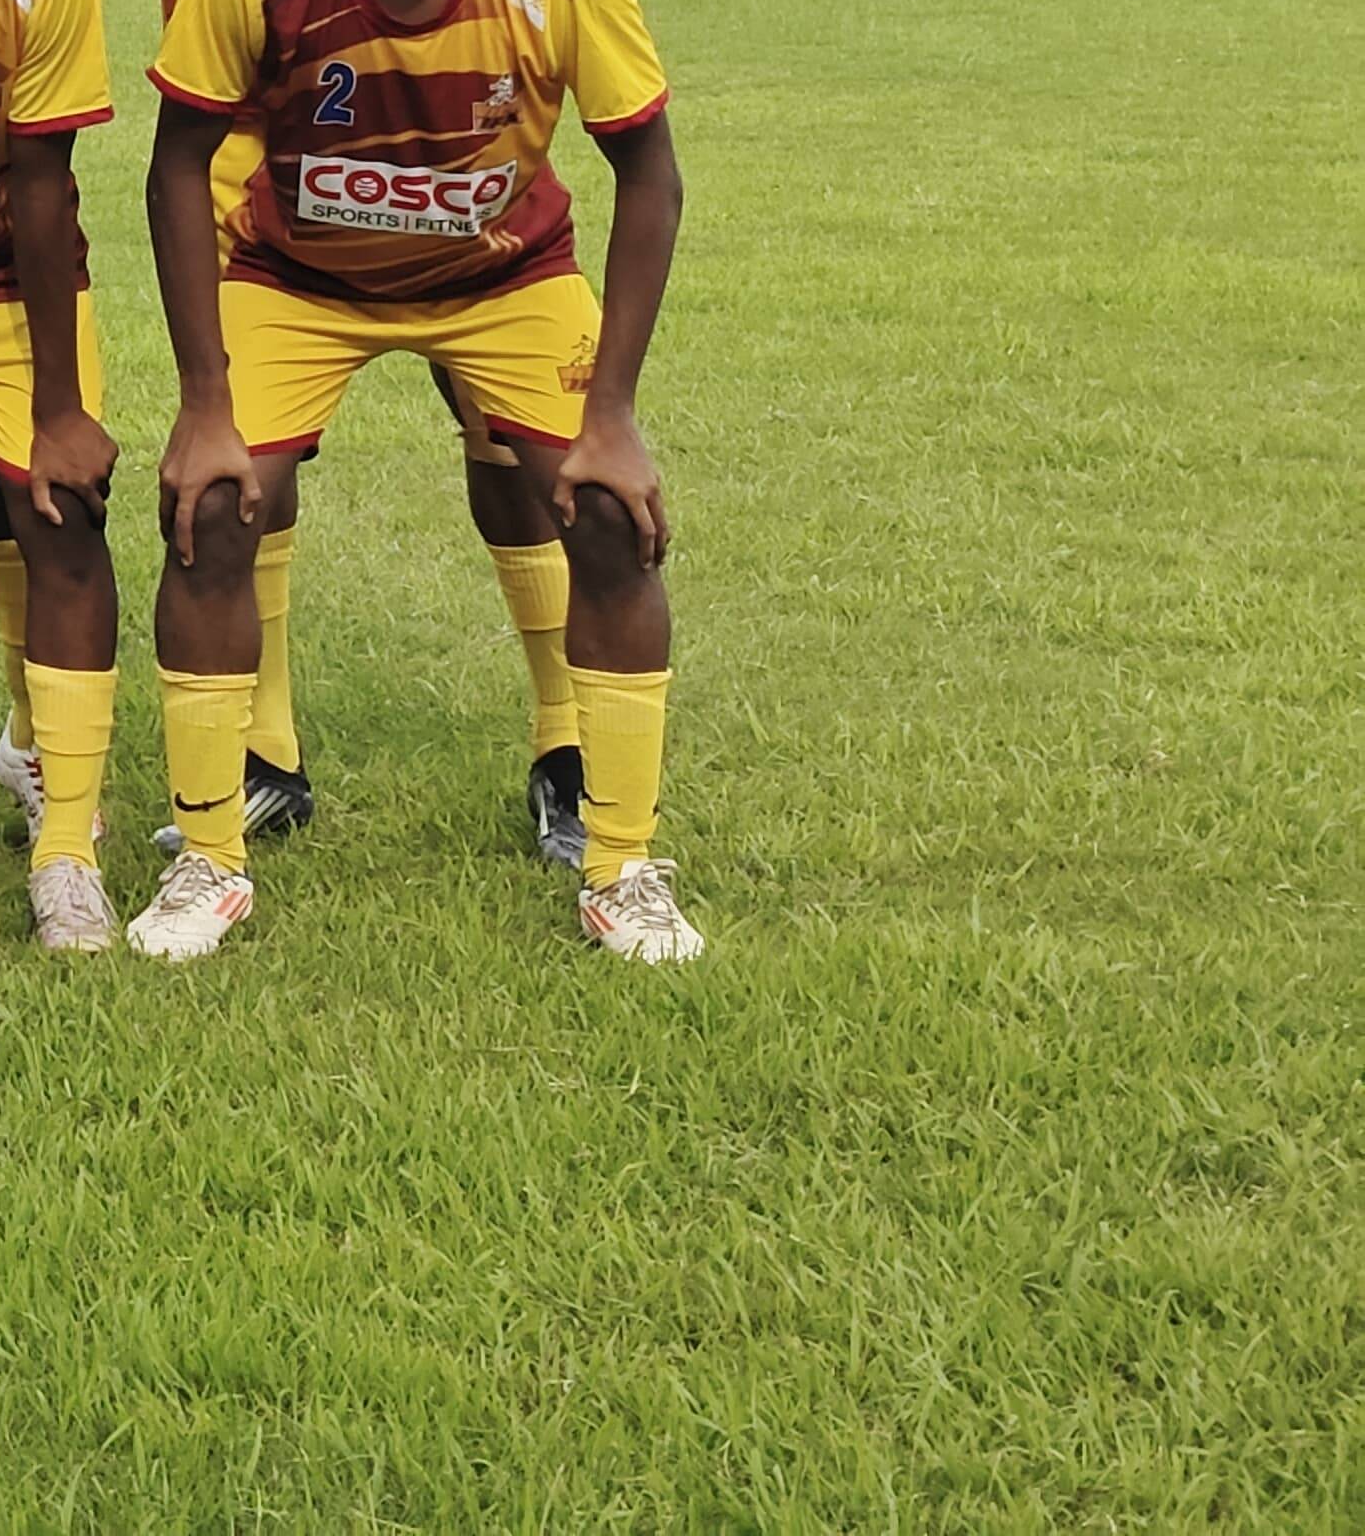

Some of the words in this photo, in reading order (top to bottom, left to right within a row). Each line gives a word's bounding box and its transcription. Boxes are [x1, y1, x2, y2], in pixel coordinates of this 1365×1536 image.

[313, 60, 357, 126] 2
[304, 165, 508, 216] COSCO
[311, 203, 400, 229] SPORTS
